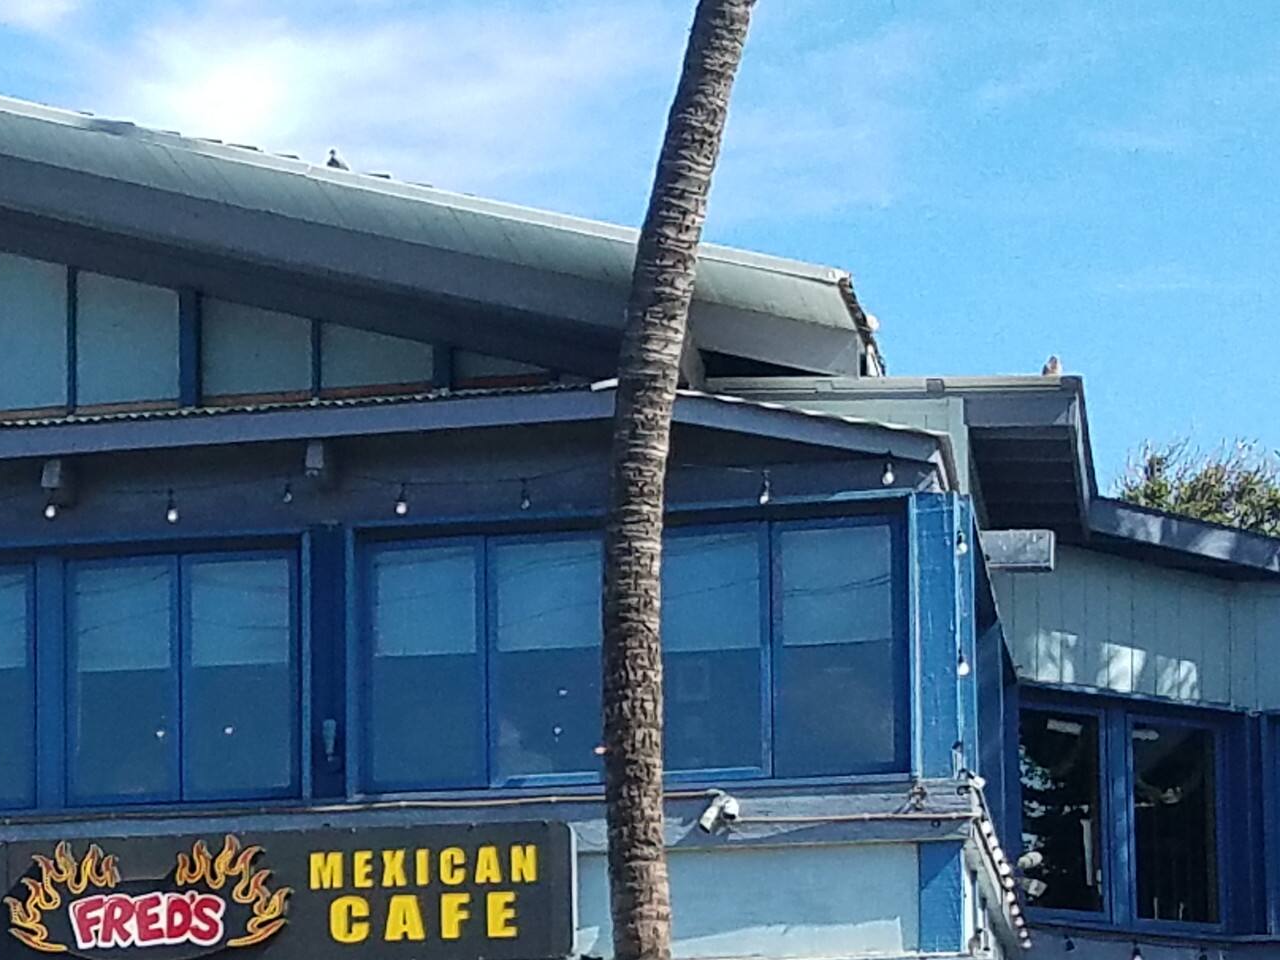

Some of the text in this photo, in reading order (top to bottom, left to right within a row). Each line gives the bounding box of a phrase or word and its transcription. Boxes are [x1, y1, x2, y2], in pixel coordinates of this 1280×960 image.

[309, 844, 538, 890] MEXICAN
[70, 891, 225, 949] FRED'S
[329, 891, 518, 943] CAFE
